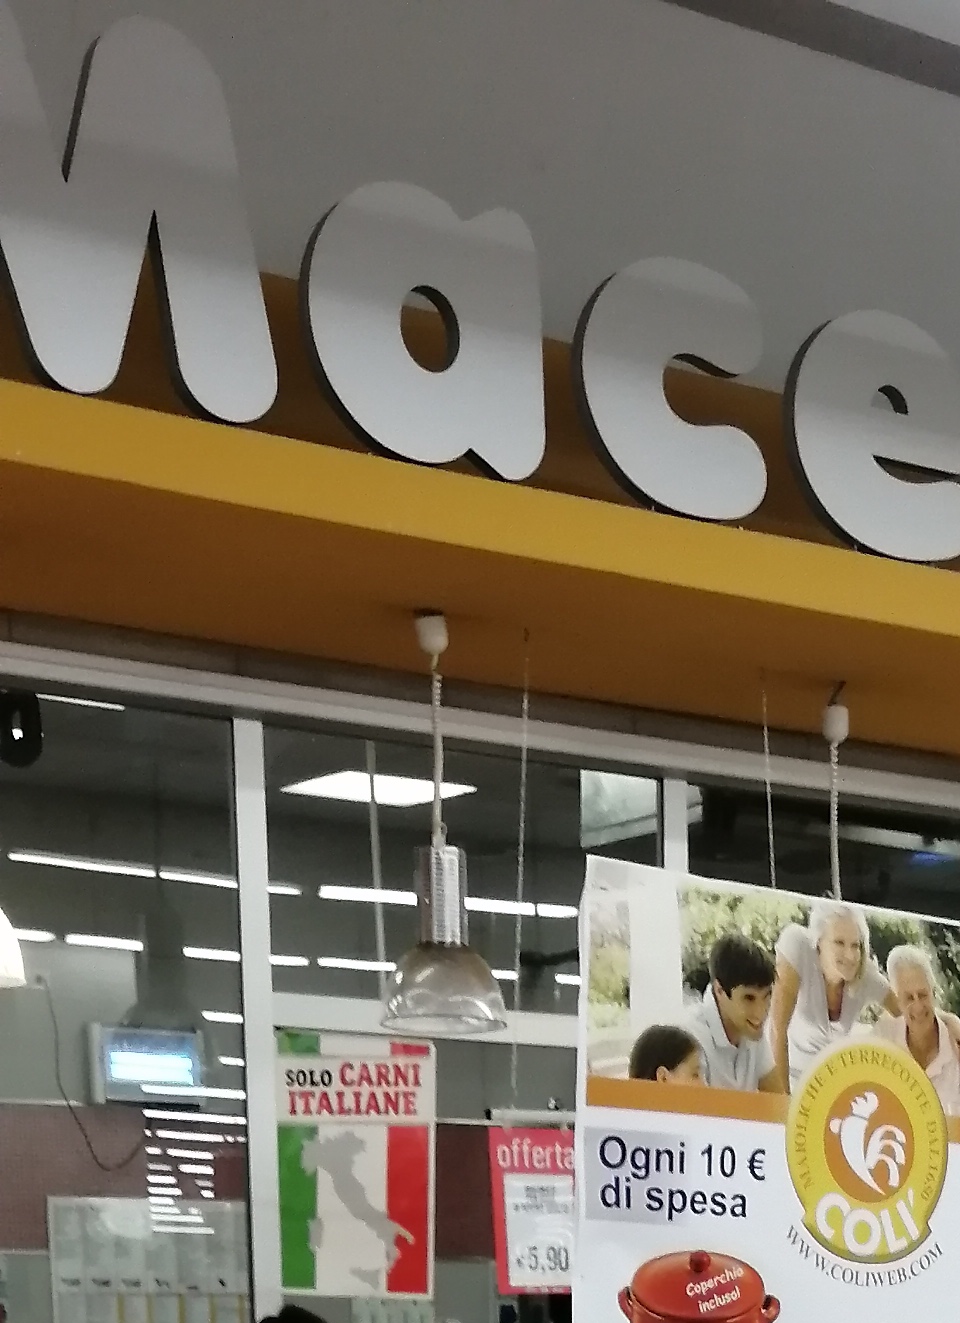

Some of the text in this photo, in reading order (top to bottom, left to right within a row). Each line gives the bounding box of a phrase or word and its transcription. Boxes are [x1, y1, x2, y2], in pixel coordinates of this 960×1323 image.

[285, 1062, 421, 1087] SOLO CARNI
[289, 1090, 417, 1116] ITALIANE
[496, 1137, 574, 1170] offerta
[600, 1135, 766, 1181] Ogni 10 €
[600, 1176, 747, 1221] di spesa
[787, 1225, 943, 1287] WWW.COLIWEB.COM
[686, 1266, 745, 1297] Coperchio
